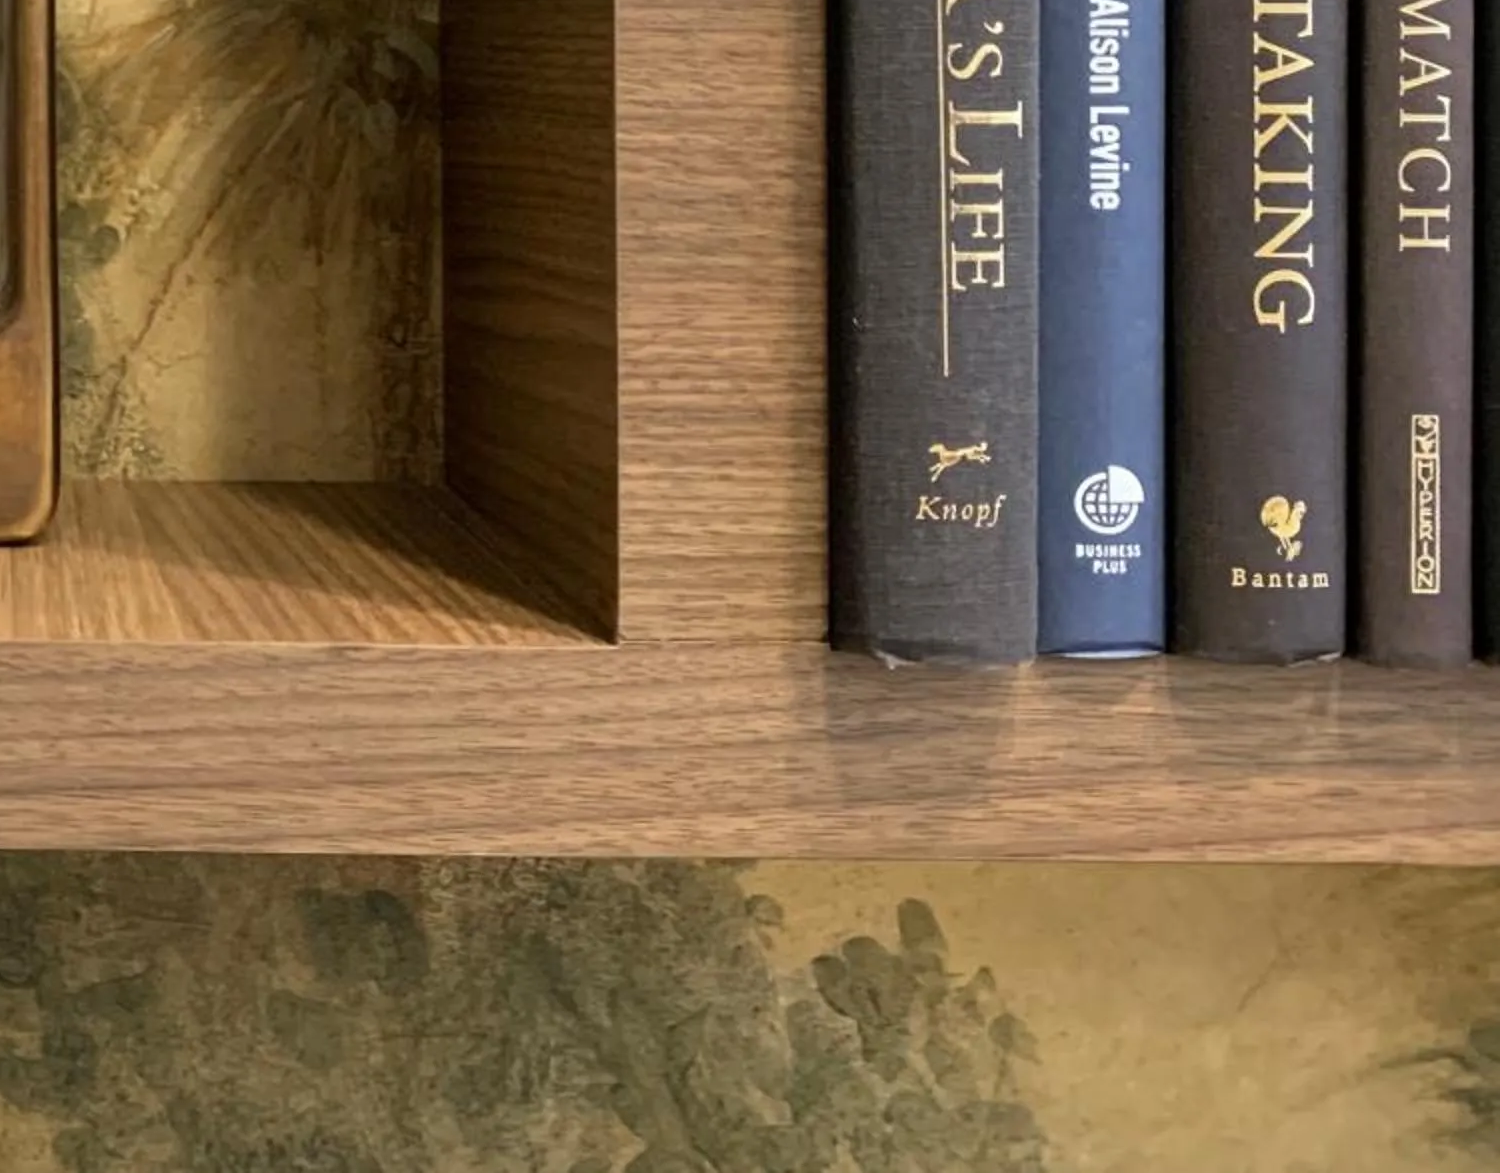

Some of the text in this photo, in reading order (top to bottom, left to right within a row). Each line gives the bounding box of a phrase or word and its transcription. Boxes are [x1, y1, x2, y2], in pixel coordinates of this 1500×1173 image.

[1088, 105, 1131, 211] Levine
[947, 100, 1024, 292] LIFE
[915, 494, 1007, 527] Knopf
[1416, 459, 1436, 588] HYPERION
[1075, 543, 1142, 559] BUSINESS
[1093, 559, 1128, 575] PLUS
[1231, 566, 1331, 590] Bantam
